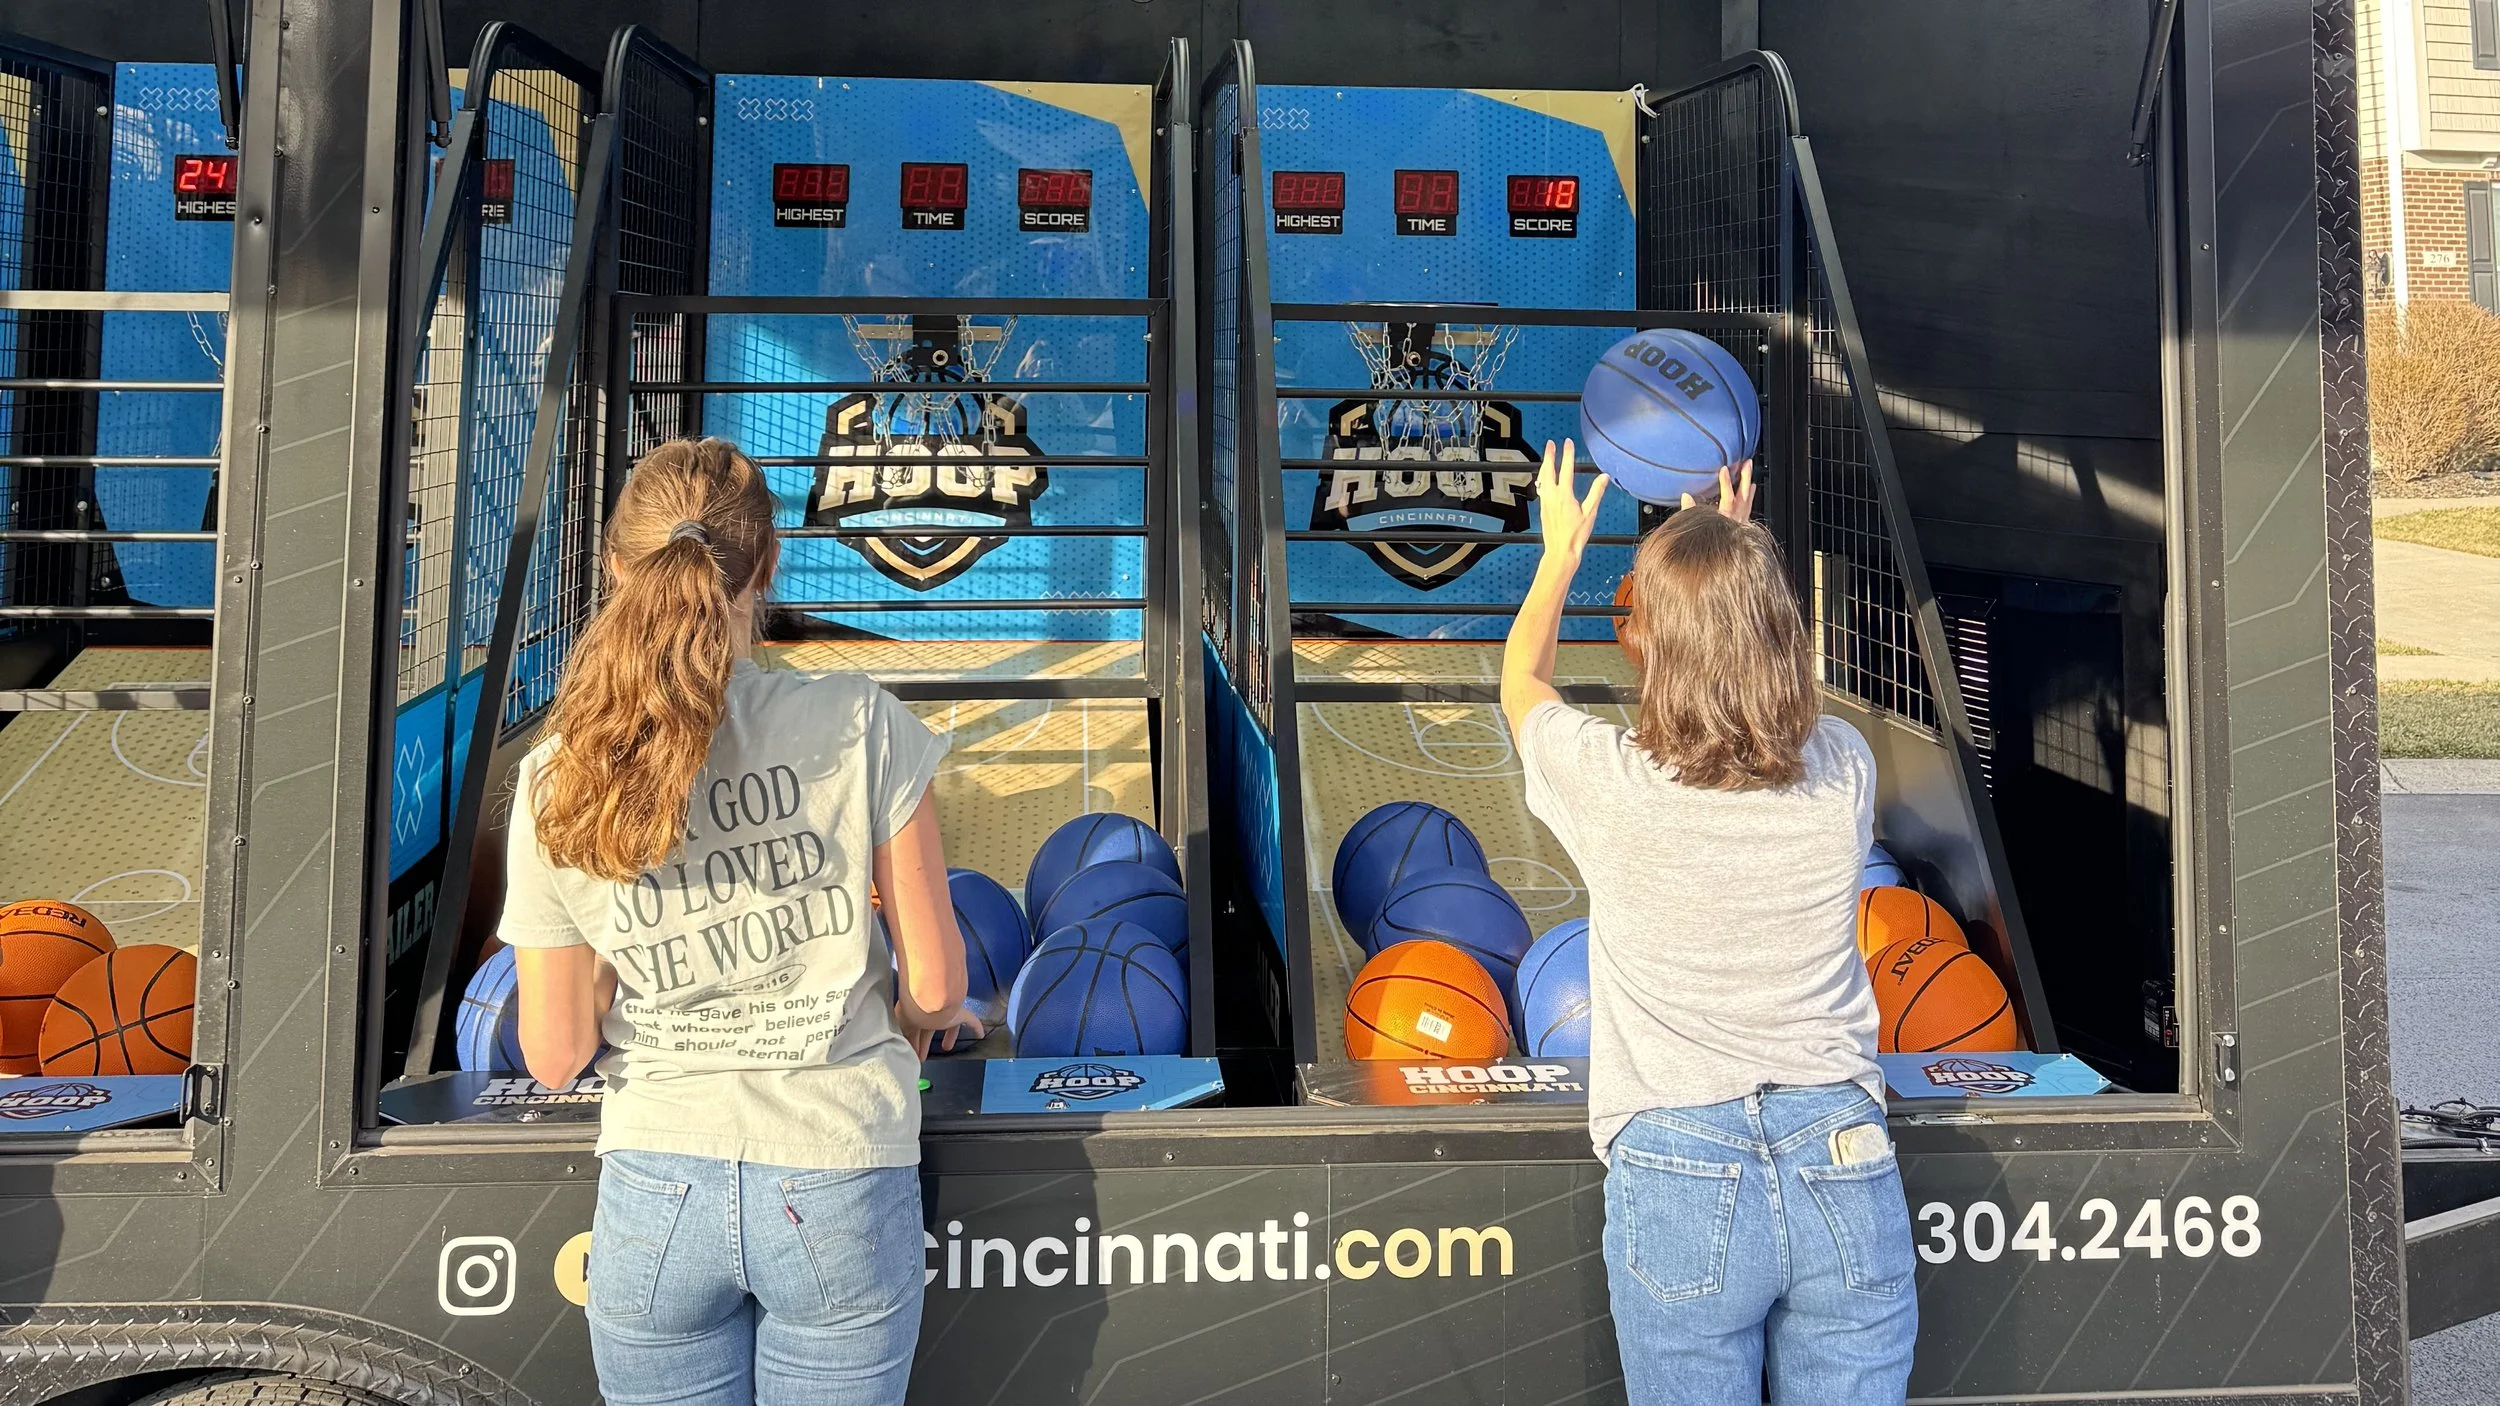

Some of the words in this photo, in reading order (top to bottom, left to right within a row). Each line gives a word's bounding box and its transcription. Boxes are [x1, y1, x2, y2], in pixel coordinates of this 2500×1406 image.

[179, 159, 228, 190] 24
[776, 207, 845, 224] HIGHEST
[912, 211, 955, 227] TIME
[1023, 212, 1085, 227] SCORE
[1275, 214, 1342, 229] HIGHEST
[1406, 217, 1447, 232] TIME
[1513, 218, 1574, 233] SCORE
[1623, 339, 1716, 401] HOOP
[818, 444, 1038, 512] HOOP
[1323, 446, 1535, 511] HOOP
[873, 511, 974, 524] CINCINNATI
[1378, 512, 1474, 526] CINCINNATI
[708, 764, 801, 833] GOD
[613, 872, 664, 934] SO
[673, 830, 826, 916] LOVED
[697, 884, 855, 976] WORLD
[752, 973, 790, 991] 3:16
[698, 1007, 742, 1022] gave
[748, 1000, 776, 1015] his
[783, 994, 819, 1010] only
[671, 1022, 754, 1035] whoever
[765, 1010, 831, 1032] believes
[633, 1028, 660, 1047] him
[674, 1038, 738, 1052] should
[755, 1035, 786, 1046] not
[737, 1048, 806, 1061] eternal
[1035, 1076, 1141, 1090] HOOP
[1398, 1064, 1571, 1085] HOOP
[1930, 1071, 2030, 1084] HOOP
[1409, 1081, 1585, 1094] CINCINNATI
[0, 1095, 107, 1108] HOOP
[1916, 1194, 2263, 1265] 304.2468
